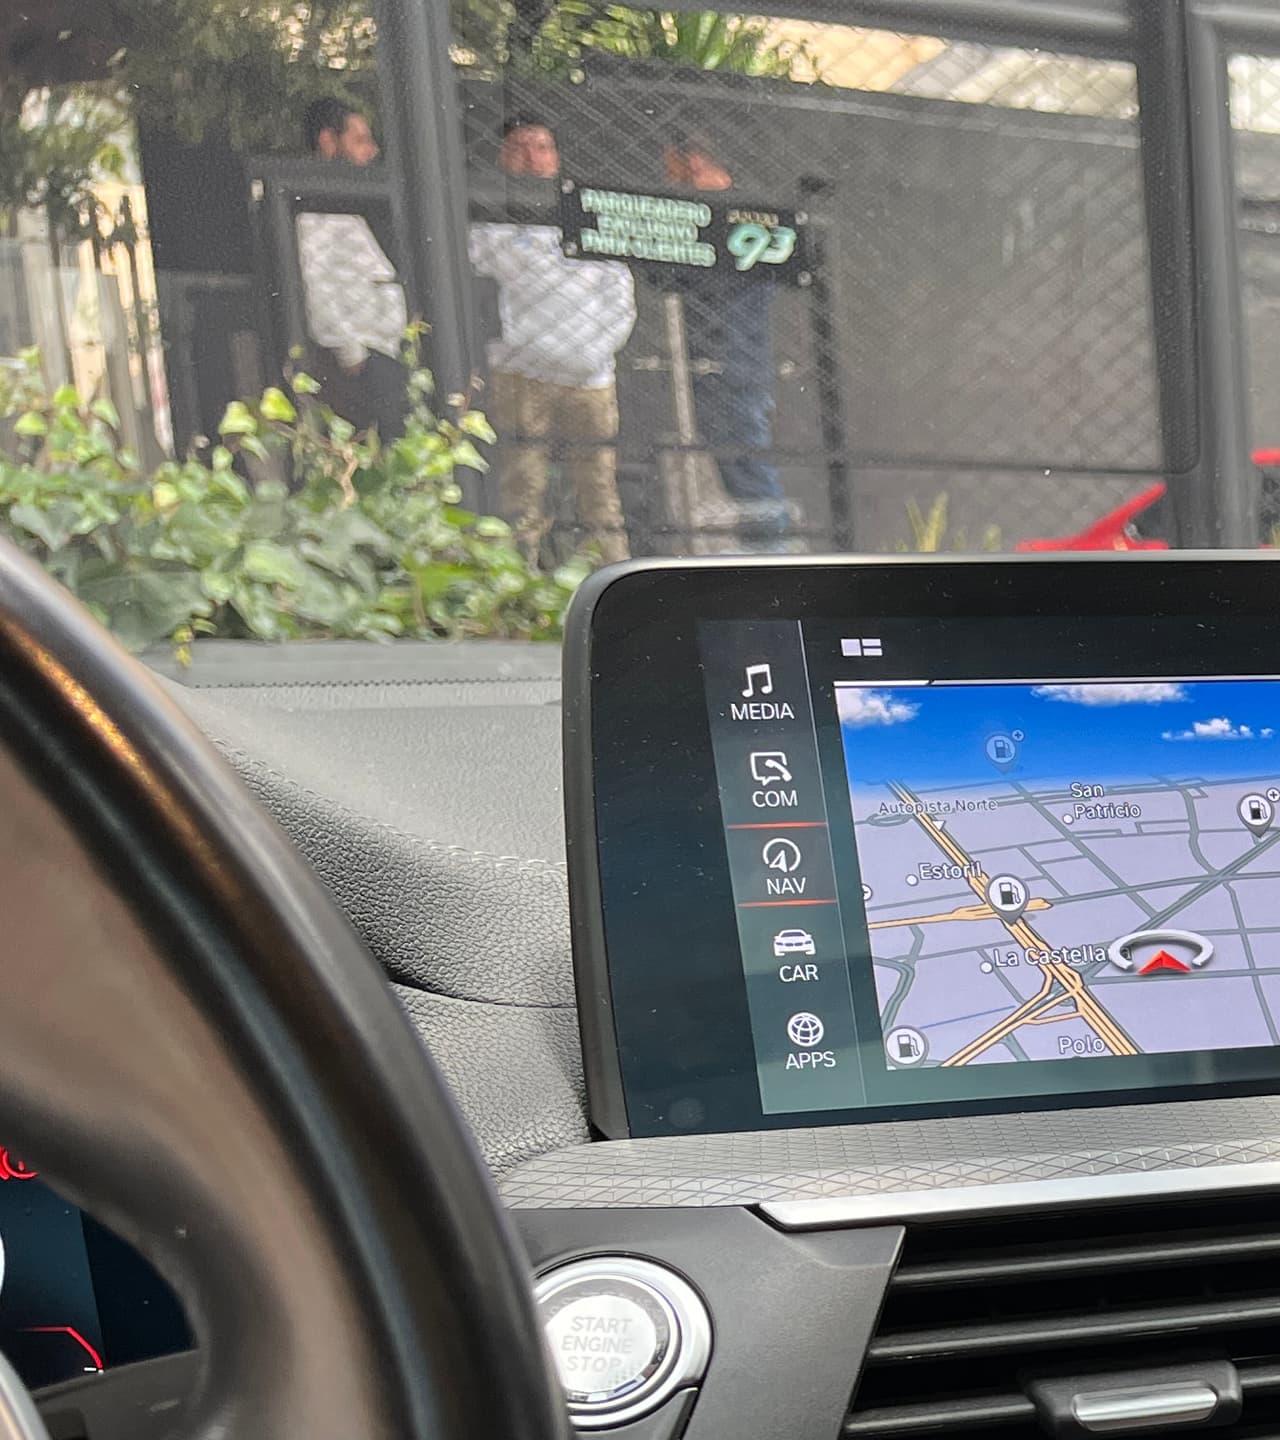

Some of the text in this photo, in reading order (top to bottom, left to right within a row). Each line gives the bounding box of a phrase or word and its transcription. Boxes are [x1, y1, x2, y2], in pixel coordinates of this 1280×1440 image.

[727, 223, 797, 271] 93
[731, 703, 794, 720] MEDIA
[752, 791, 797, 808] COM
[1071, 783, 1104, 799] San
[879, 797, 998, 816] Autopista Norte
[1074, 803, 1141, 820] Patricio
[919, 862, 983, 880] Estoril
[767, 879, 805, 895] NAV
[994, 943, 1132, 967] La Castellaa
[780, 966, 819, 981] CAR
[1057, 1035, 1104, 1055] Polo
[785, 1052, 837, 1070] APPS
[571, 1315, 632, 1332] START
[561, 1336, 633, 1352] ENGINE
[566, 1356, 622, 1371] STOP
